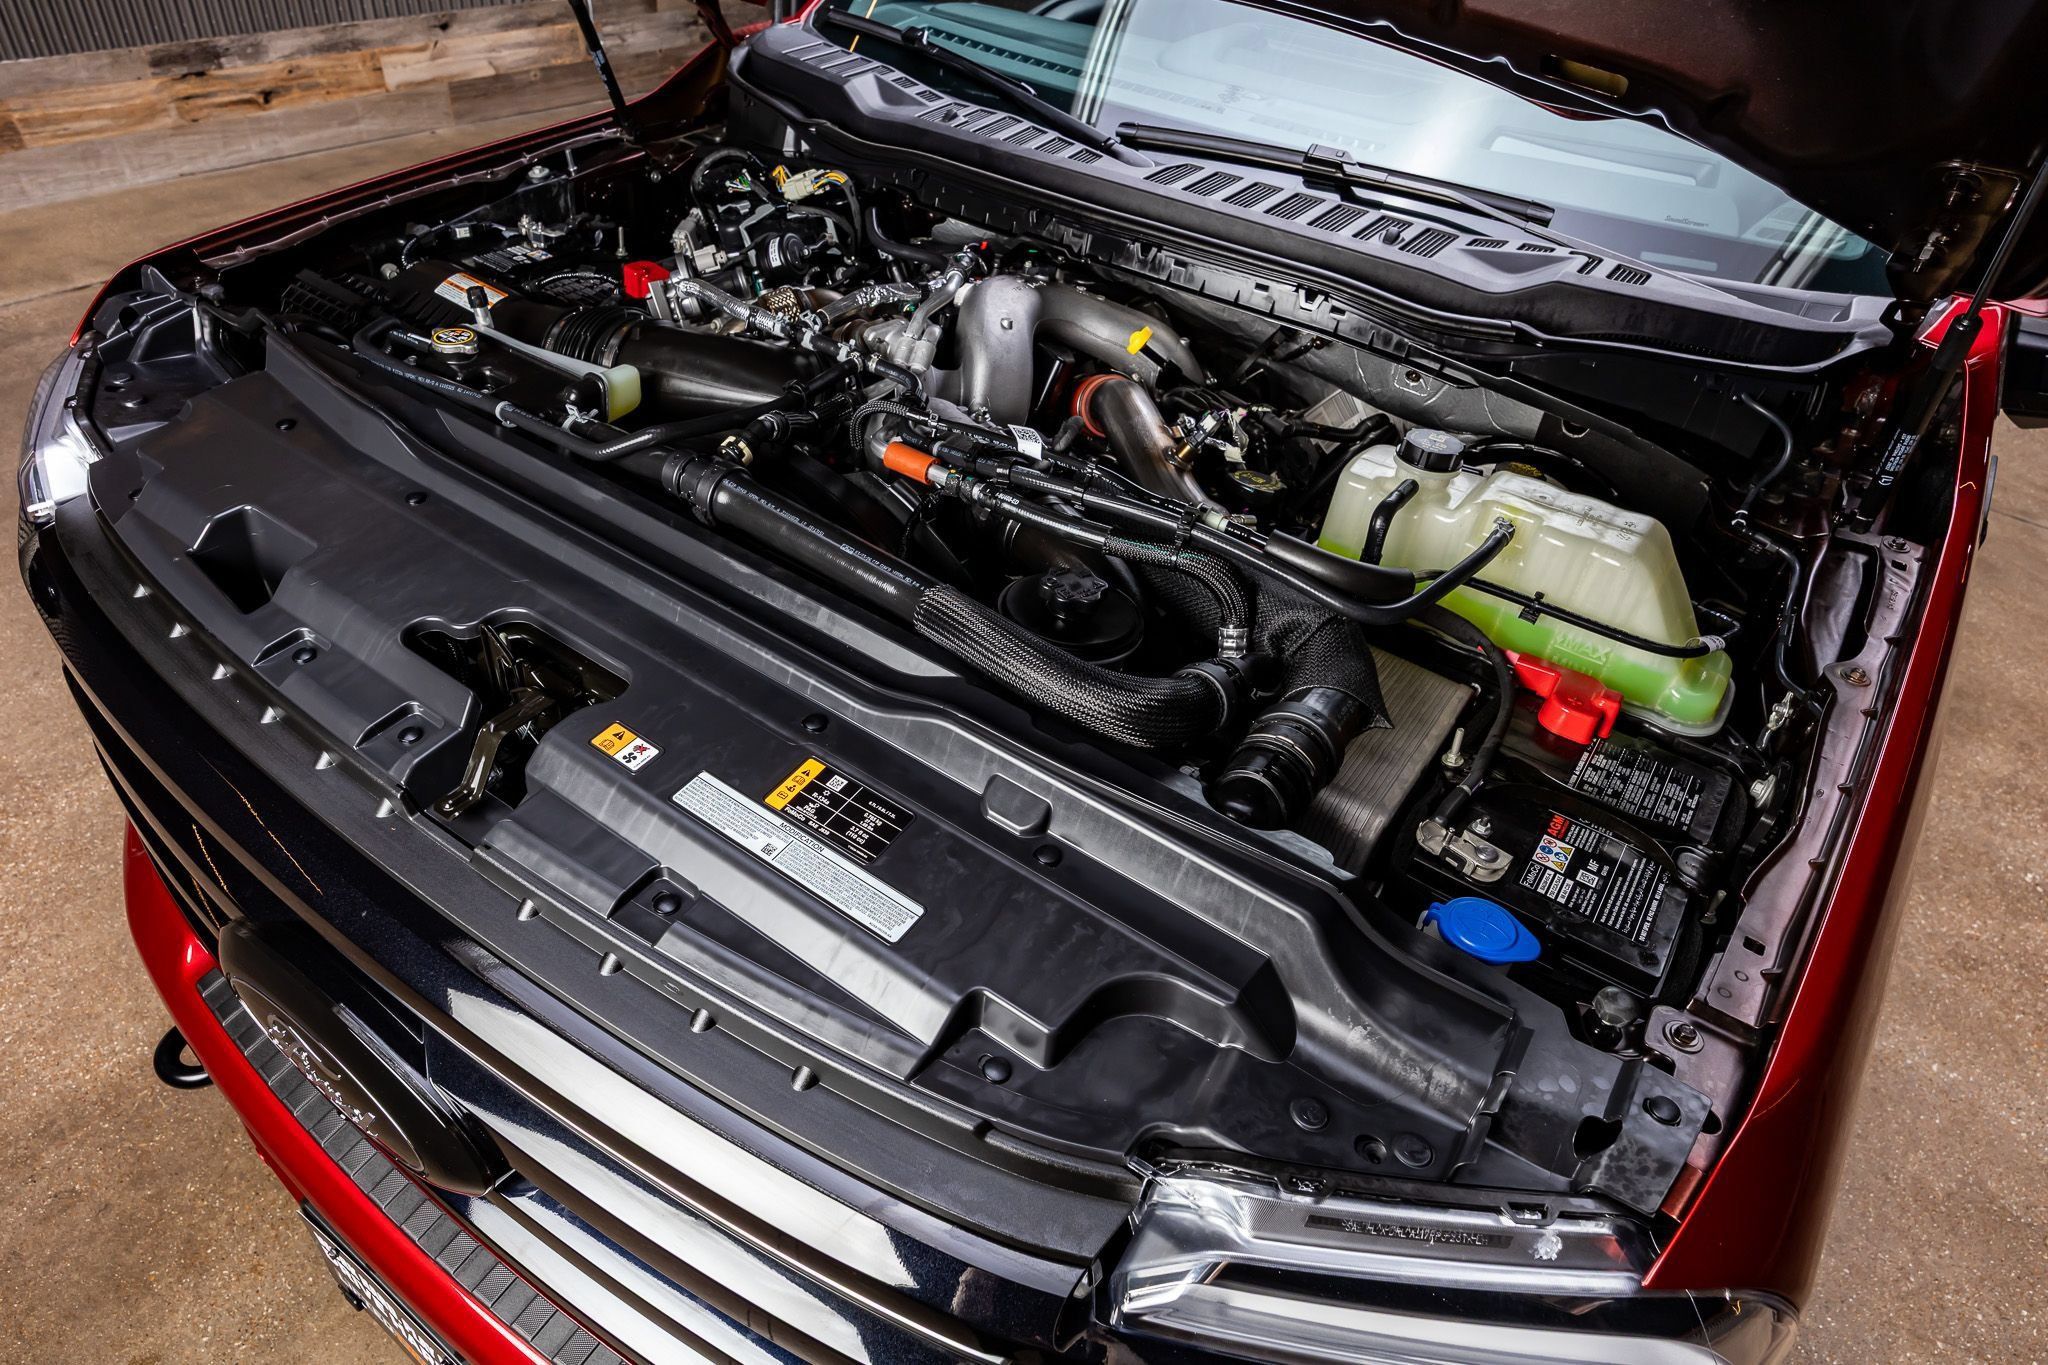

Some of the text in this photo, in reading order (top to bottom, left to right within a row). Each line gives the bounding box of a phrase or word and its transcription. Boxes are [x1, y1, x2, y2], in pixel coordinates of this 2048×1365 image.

[1547, 814, 1563, 836] AGM
[778, 822, 825, 852] MODIFICATION
[1524, 862, 1540, 887] FoMoCo
[1587, 858, 1599, 872] MF
